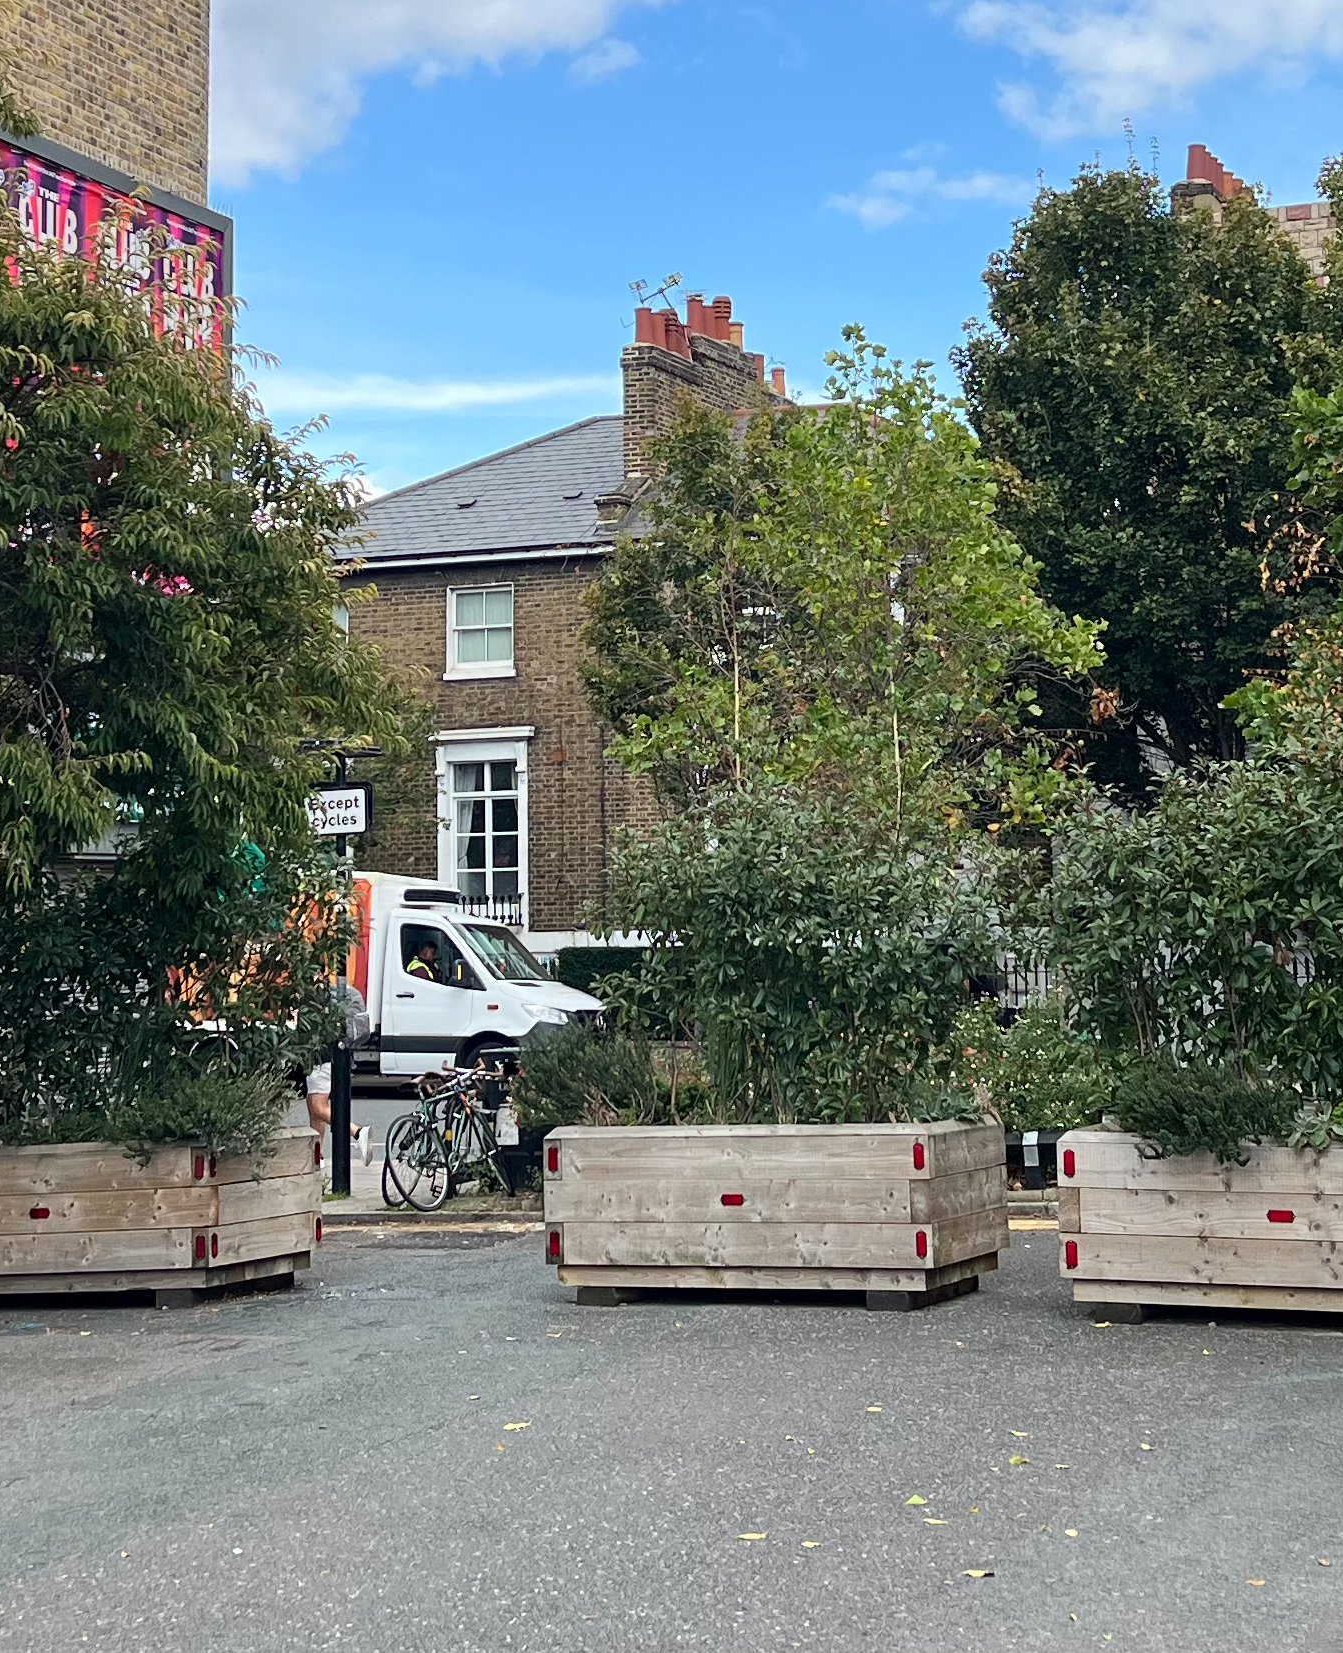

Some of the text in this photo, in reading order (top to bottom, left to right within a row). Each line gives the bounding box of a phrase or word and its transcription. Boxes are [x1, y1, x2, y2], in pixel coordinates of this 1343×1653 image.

[38, 186, 60, 203] THE
[18, 194, 78, 254] CLUB
[312, 813, 358, 829] cycles
